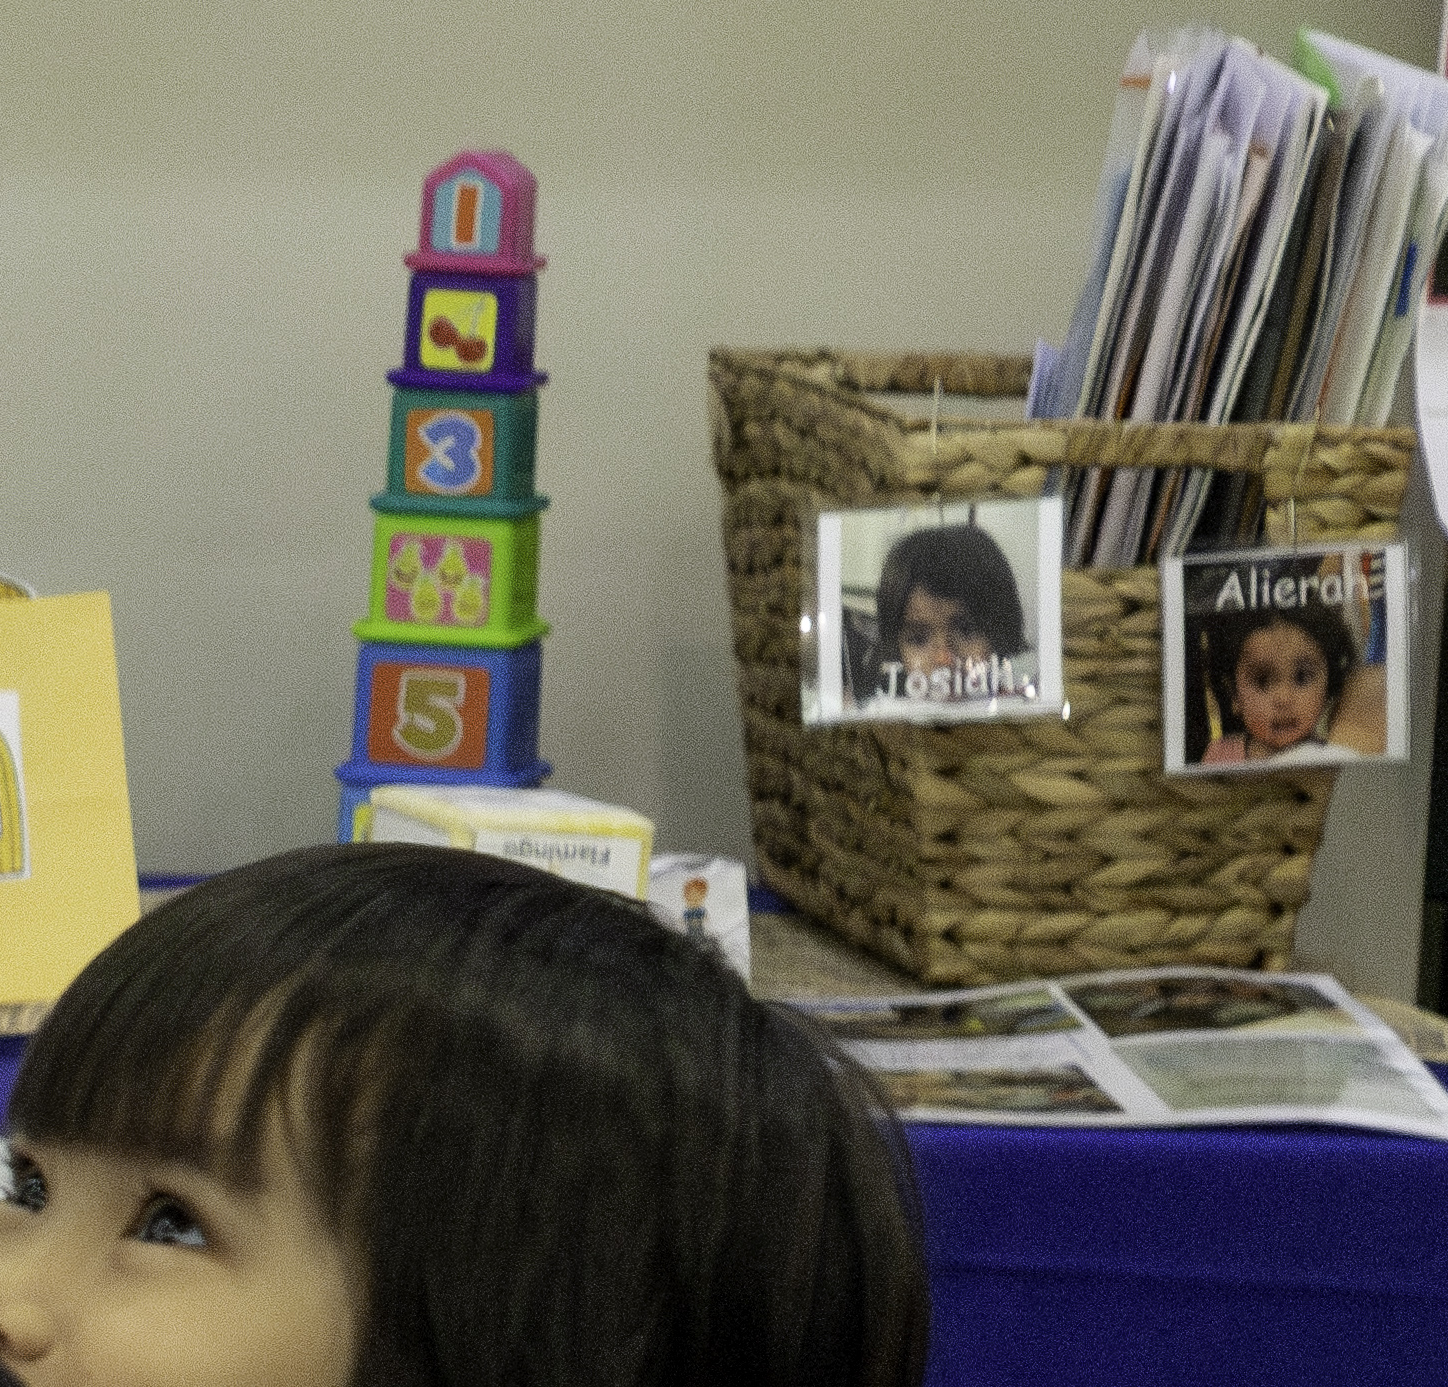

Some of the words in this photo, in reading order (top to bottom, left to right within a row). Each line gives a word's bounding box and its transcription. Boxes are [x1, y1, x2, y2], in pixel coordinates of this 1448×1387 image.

[415, 408, 483, 494] 3
[1215, 565, 1369, 611] Alierah
[393, 668, 467, 760] 5
